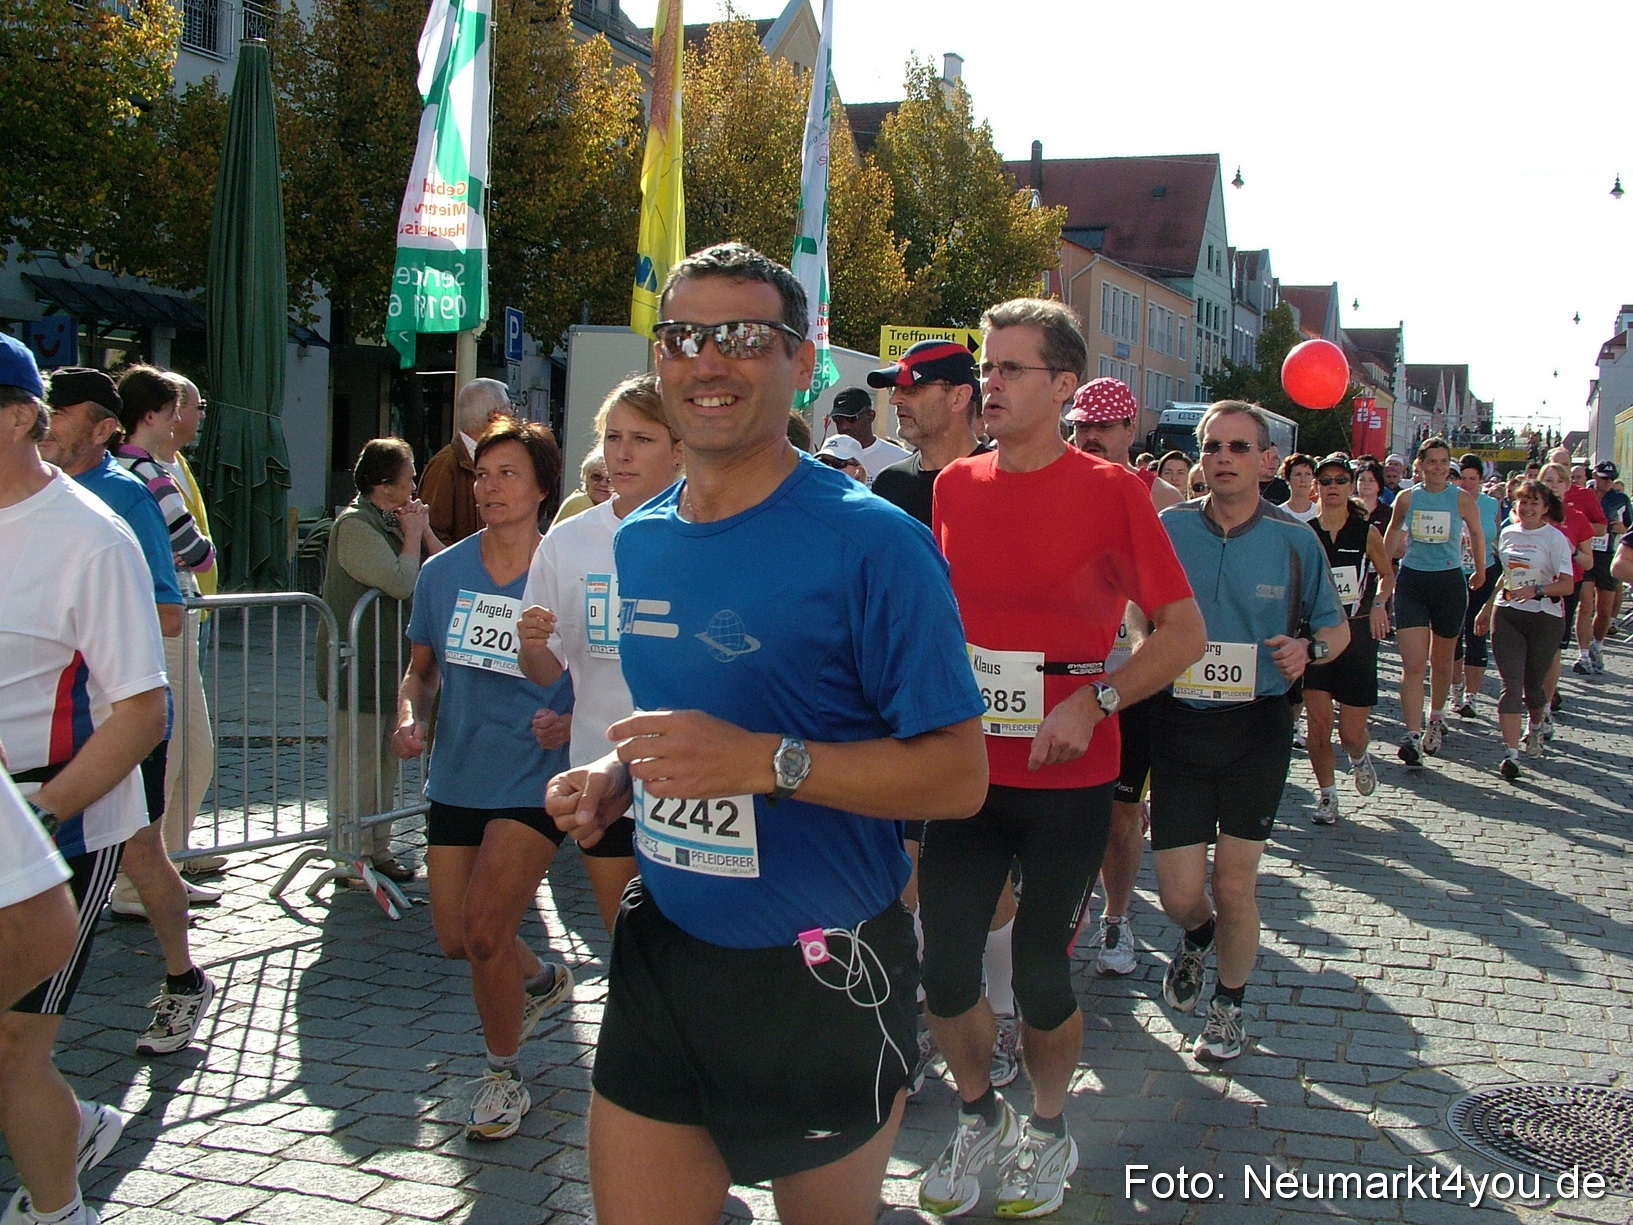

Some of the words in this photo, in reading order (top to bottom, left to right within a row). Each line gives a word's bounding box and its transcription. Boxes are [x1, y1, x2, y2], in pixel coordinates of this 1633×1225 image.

[510, 315, 520, 352] P
[889, 329, 956, 342] Treffpunkt
[1424, 525, 1444, 535] 114
[475, 599, 513, 619] Angela
[470, 625, 518, 655] 320
[973, 653, 1001, 676] Klaus
[1204, 663, 1242, 683] 630
[981, 687, 1027, 713] 685
[649, 797, 741, 838] 2242
[691, 850, 755, 868] PFLEIDERER
